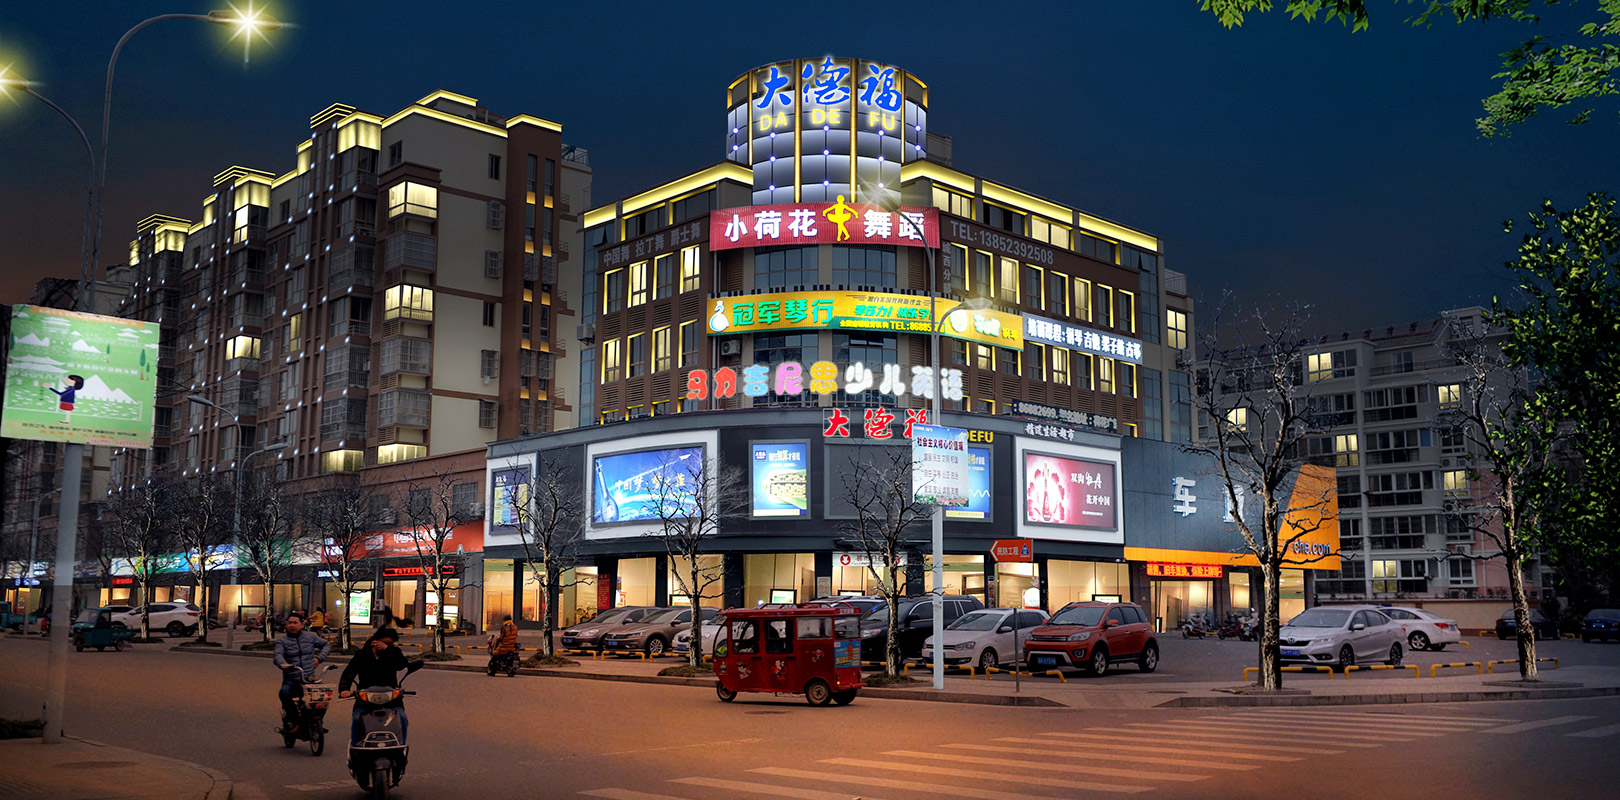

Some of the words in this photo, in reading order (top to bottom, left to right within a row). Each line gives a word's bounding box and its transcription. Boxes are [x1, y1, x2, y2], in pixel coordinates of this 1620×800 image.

[756, 56, 902, 112] 大德福
[760, 112, 788, 131] DA
[812, 109, 841, 124] DE
[869, 111, 896, 131] FU
[724, 209, 818, 242] 小荷花
[864, 209, 925, 241] 舞蹈
[603, 245, 630, 266] 中国舞
[635, 234, 664, 258] 拉丁舞
[670, 222, 700, 247] 爵士舞
[950, 220, 1055, 265] TEL:13852392508
[732, 298, 835, 326] 冠军琴行
[917, 437, 964, 452] 社会主义核心价值观
[996, 546, 1019, 556] 民防工程
